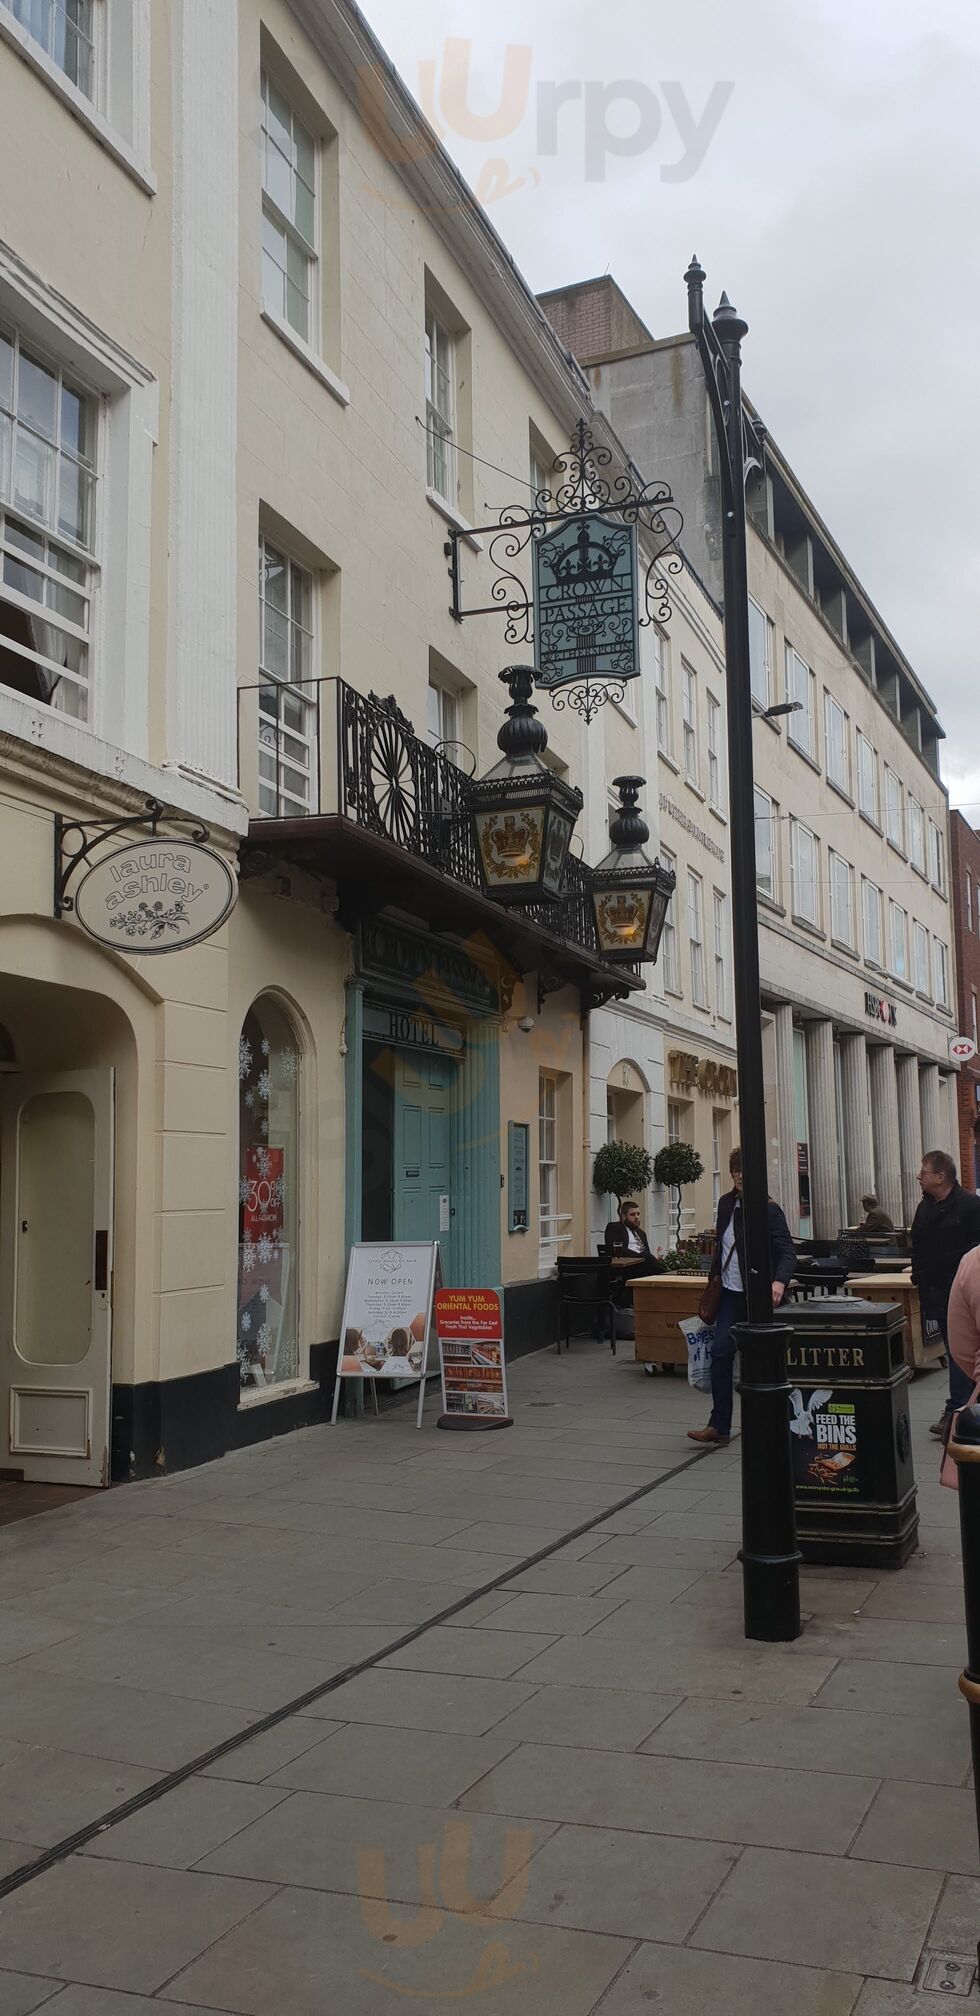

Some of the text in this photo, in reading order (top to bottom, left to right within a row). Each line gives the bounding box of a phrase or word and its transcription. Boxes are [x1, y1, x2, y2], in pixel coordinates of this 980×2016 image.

[545, 575, 625, 601] CROWN
[544, 598, 630, 624] PASSAGE
[543, 642, 632, 662] WETHERSPOON
[109, 852, 192, 884] laura
[105, 873, 203, 911] ashley
[389, 1012, 439, 1048] HOTEL
[668, 1049, 698, 1087] THE
[367, 1277, 413, 1286] NOW OPEN
[436, 1302, 499, 1311] ORIENTAL FOODS
[448, 1295, 486, 1303] YUM YUM
[686, 1330, 714, 1345] Bags
[693, 1347, 701, 1361] of
[786, 1347, 865, 1367] LITTER
[815, 1414, 856, 1425] FEED THE
[816, 1425, 857, 1444] BINS
